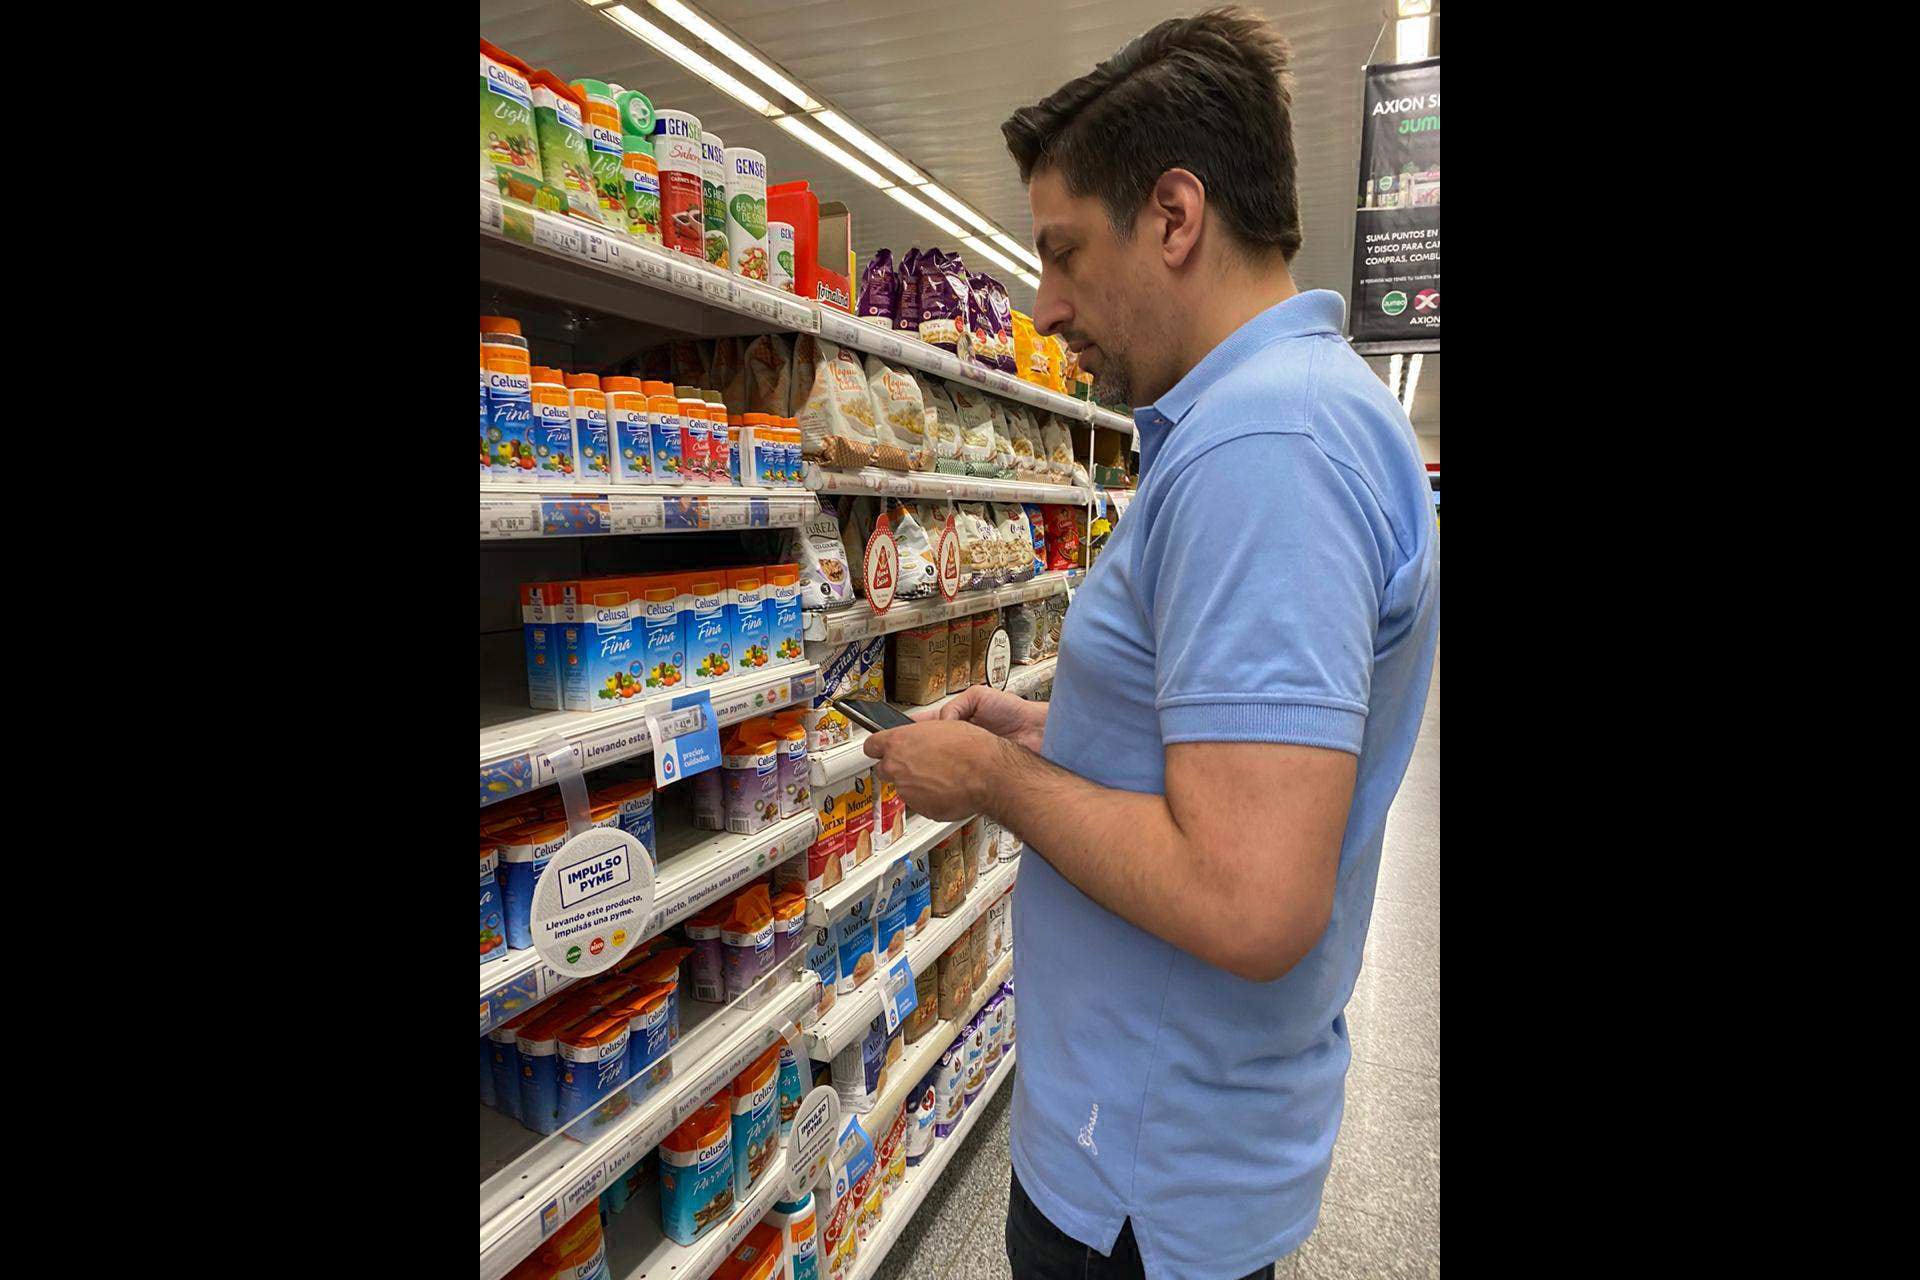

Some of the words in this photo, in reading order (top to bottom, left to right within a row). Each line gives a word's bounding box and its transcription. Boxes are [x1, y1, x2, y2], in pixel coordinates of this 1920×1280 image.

[1373, 96, 1424, 116] AXION
[668, 118, 701, 141] GENSE
[1399, 114, 1440, 134] JUM
[593, 128, 621, 145] Celus
[736, 158, 766, 180] GENSE
[1366, 232, 1390, 243] SUMÁ
[1391, 230, 1425, 241] PUNTOS
[1426, 229, 1439, 238] EN
[1367, 246, 1373, 254] Y
[1374, 243, 1400, 254] DISCO
[1401, 242, 1423, 251] PARA
[493, 403, 530, 423] Fina
[738, 593, 760, 604] Celusal
[775, 587, 794, 598] Celusal
[646, 602, 675, 616] Celusal
[695, 596, 720, 610] Celusal
[597, 608, 629, 623] Celusal
[741, 615, 762, 632] Fina
[778, 609, 796, 626] Fina
[648, 629, 676, 649] Fina
[698, 621, 721, 640] Fina
[601, 636, 632, 658] Fina
[716, 706, 729, 718] una
[587, 739, 627, 757] Llevando
[628, 734, 645, 745] este
[568, 855, 622, 884] IMPULSO
[580, 871, 613, 892] PYME
[666, 901, 687, 916] ucto,
[719, 876, 731, 887] una
[545, 913, 584, 931] Llevando
[586, 907, 604, 917] este
[605, 895, 643, 912] producto,
[554, 921, 592, 939] impulsás
[593, 916, 608, 926] una
[609, 908, 634, 921] pyme.
[600, 1034, 626, 1058] Celusal
[801, 1103, 827, 1135] IMPULSO
[699, 1135, 729, 1163] Celusal
[568, 1169, 603, 1203] IMPULSO
